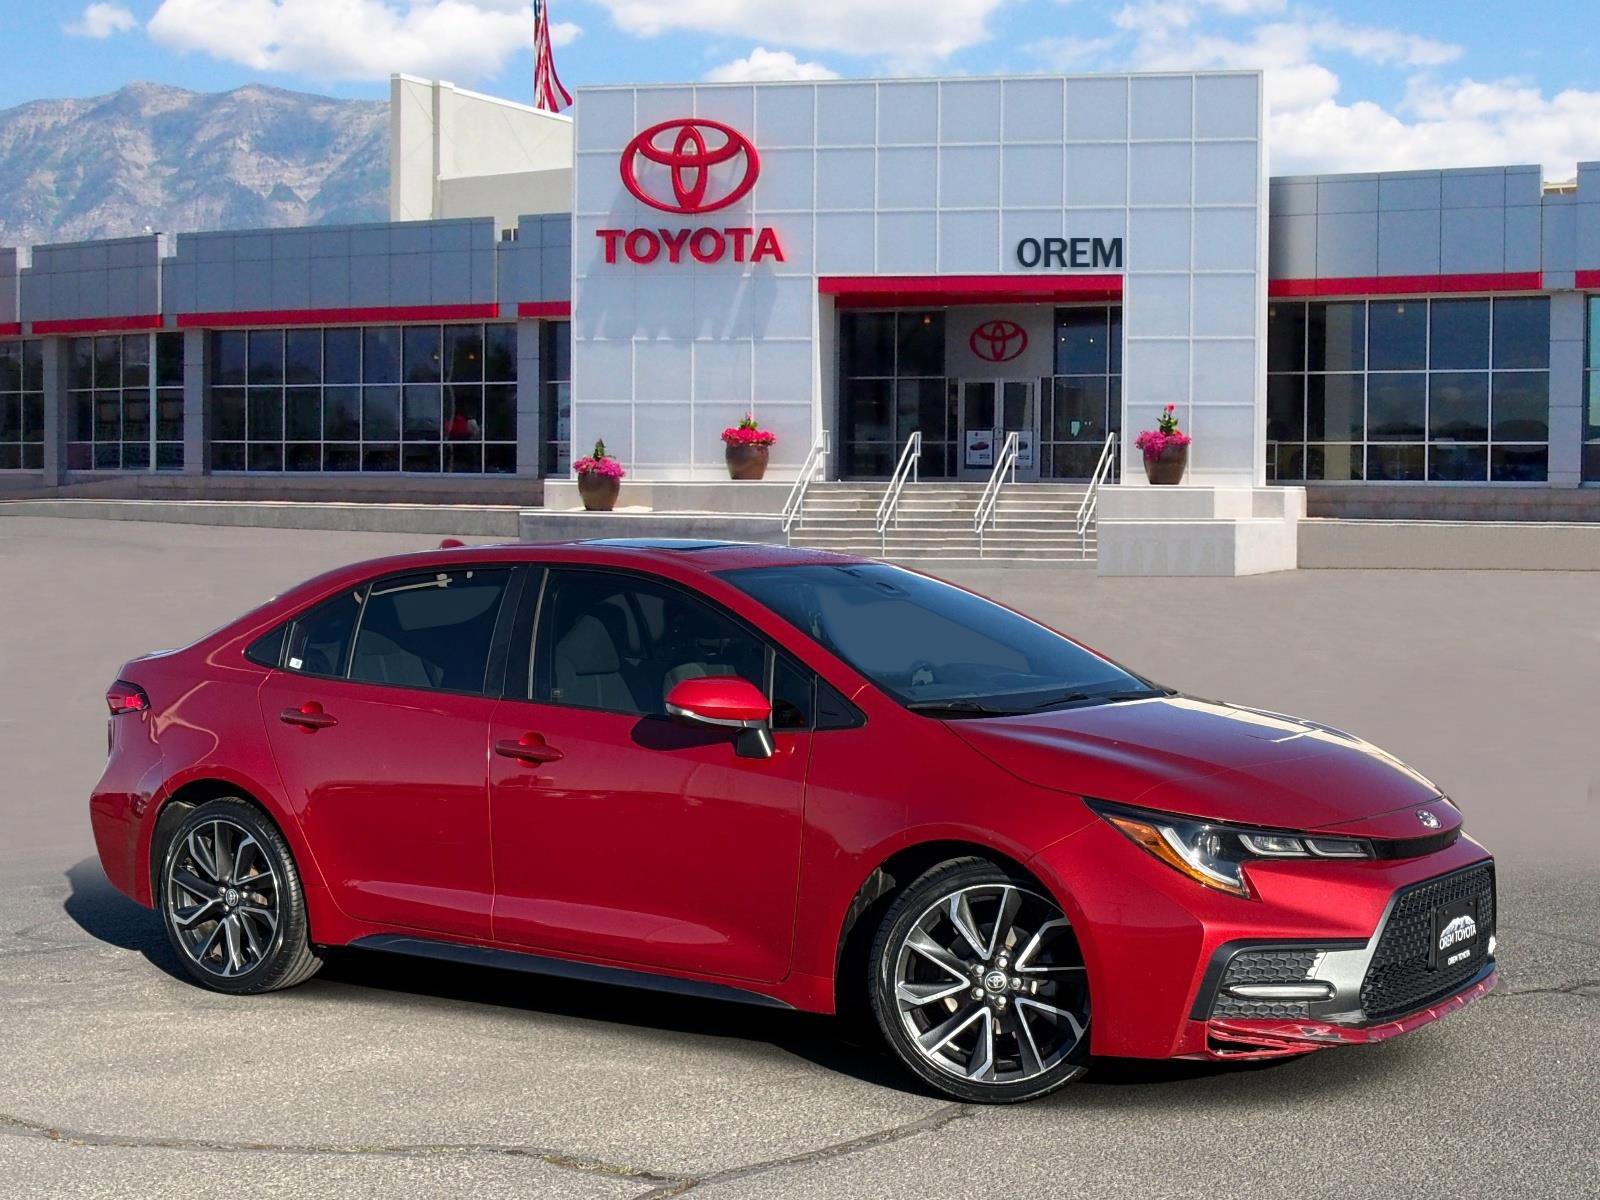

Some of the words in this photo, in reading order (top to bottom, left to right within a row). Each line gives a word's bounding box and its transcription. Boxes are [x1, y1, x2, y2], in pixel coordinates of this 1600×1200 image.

[596, 227, 785, 265] TOYOTA
[1016, 236, 1123, 268] OREM
[1439, 933, 1454, 950] OREM
[1455, 924, 1476, 942] TOYOTA
[1458, 950, 1470, 961] TOYOTA
